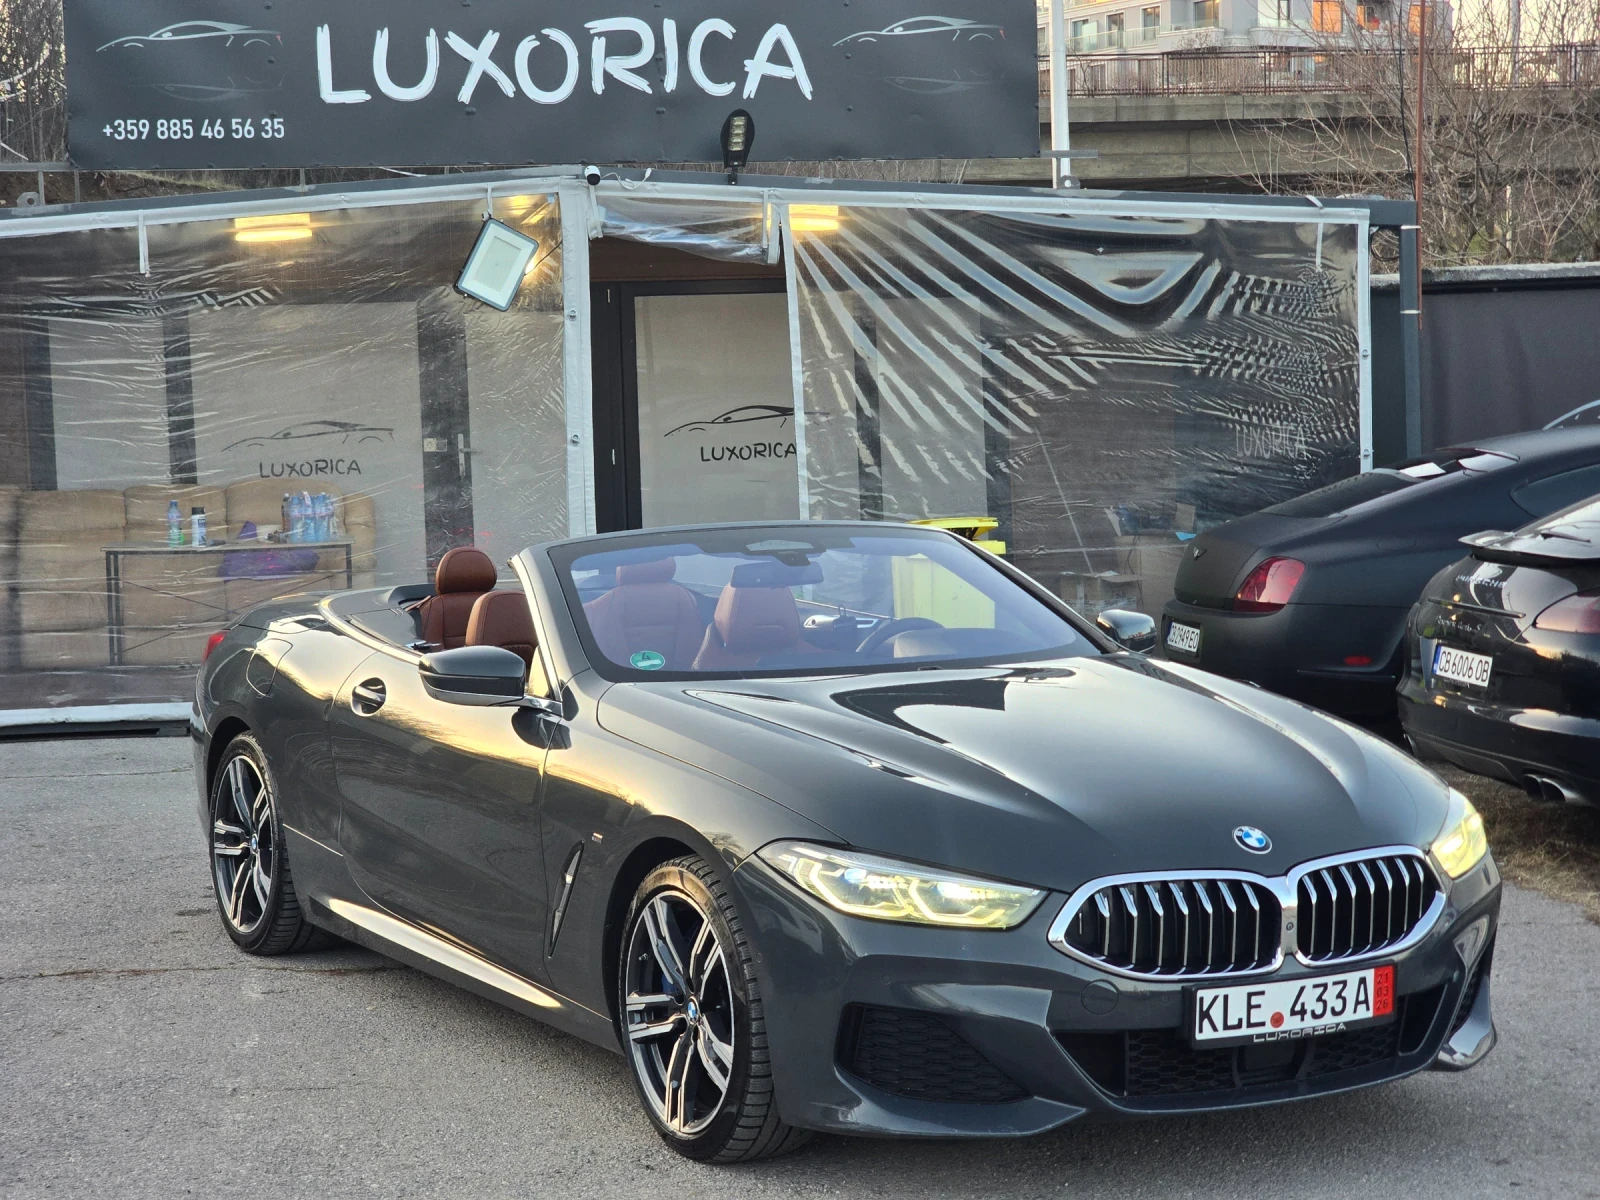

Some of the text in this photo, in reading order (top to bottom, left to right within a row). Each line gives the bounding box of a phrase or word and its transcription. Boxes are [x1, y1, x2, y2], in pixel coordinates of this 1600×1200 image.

[316, 17, 813, 105] LUXORICA
[103, 118, 285, 140] +359 885 46 56 35
[700, 442, 797, 462] LUXORICA
[259, 459, 362, 479] LUXORICA
[1439, 651, 1452, 673] CB
[1451, 653, 1475, 679] 6006
[1475, 659, 1490, 683] OB
[1376, 970, 1389, 985] 21
[1376, 984, 1389, 998] 03
[1198, 976, 1370, 1034] KLE 433A
[1253, 1022, 1347, 1043] LUXORICA
